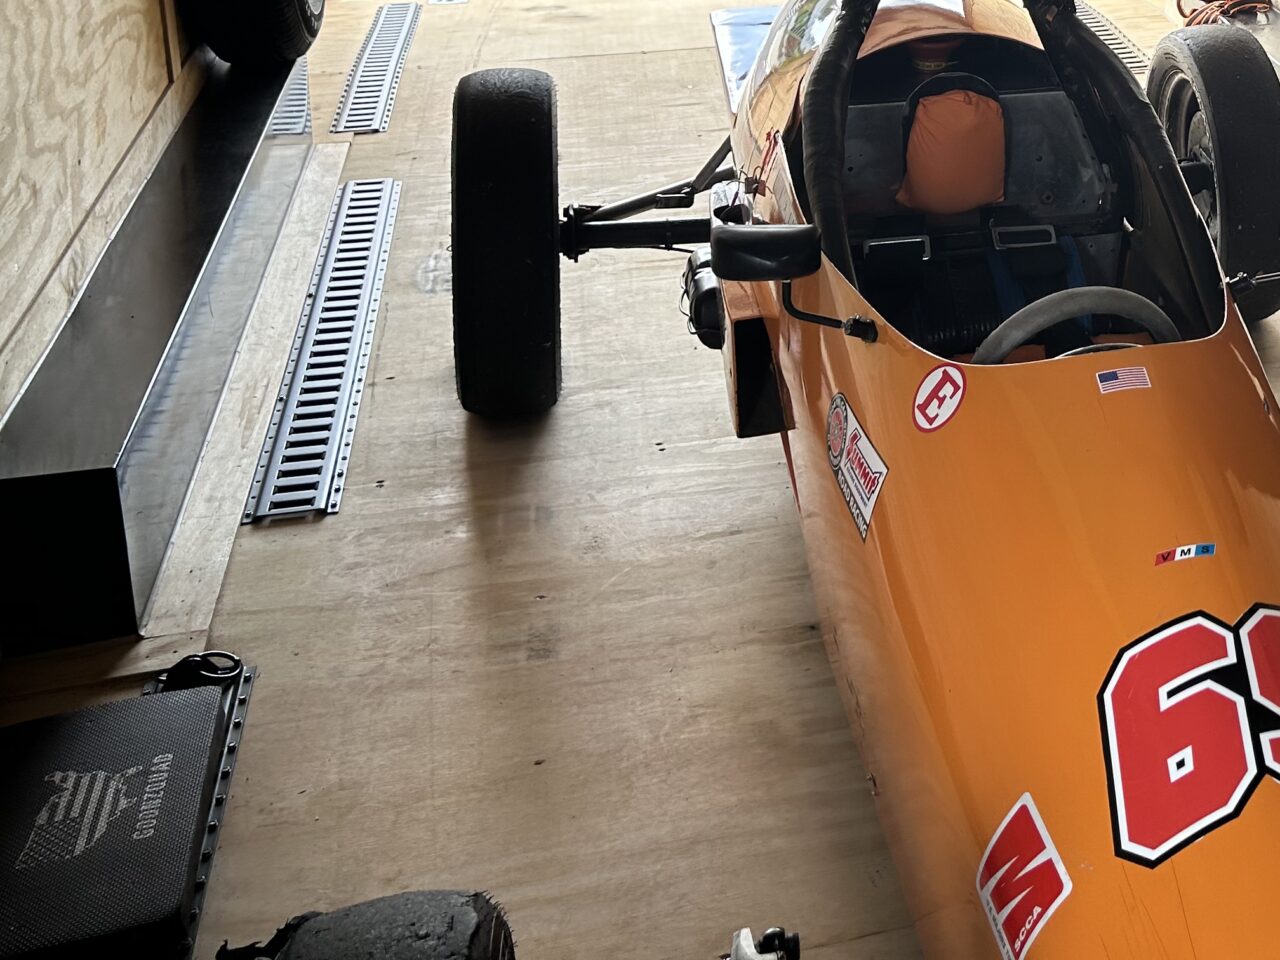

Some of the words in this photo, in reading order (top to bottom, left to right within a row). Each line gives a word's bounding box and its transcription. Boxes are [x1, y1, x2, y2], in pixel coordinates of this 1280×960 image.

[916, 369, 962, 426] E
[846, 430, 879, 497] SUMMIT
[837, 469, 851, 502] ROAD
[848, 500, 868, 540] RACING
[133, 753, 174, 839] GOONZQUAD
[1013, 905, 1043, 953] SCCA
